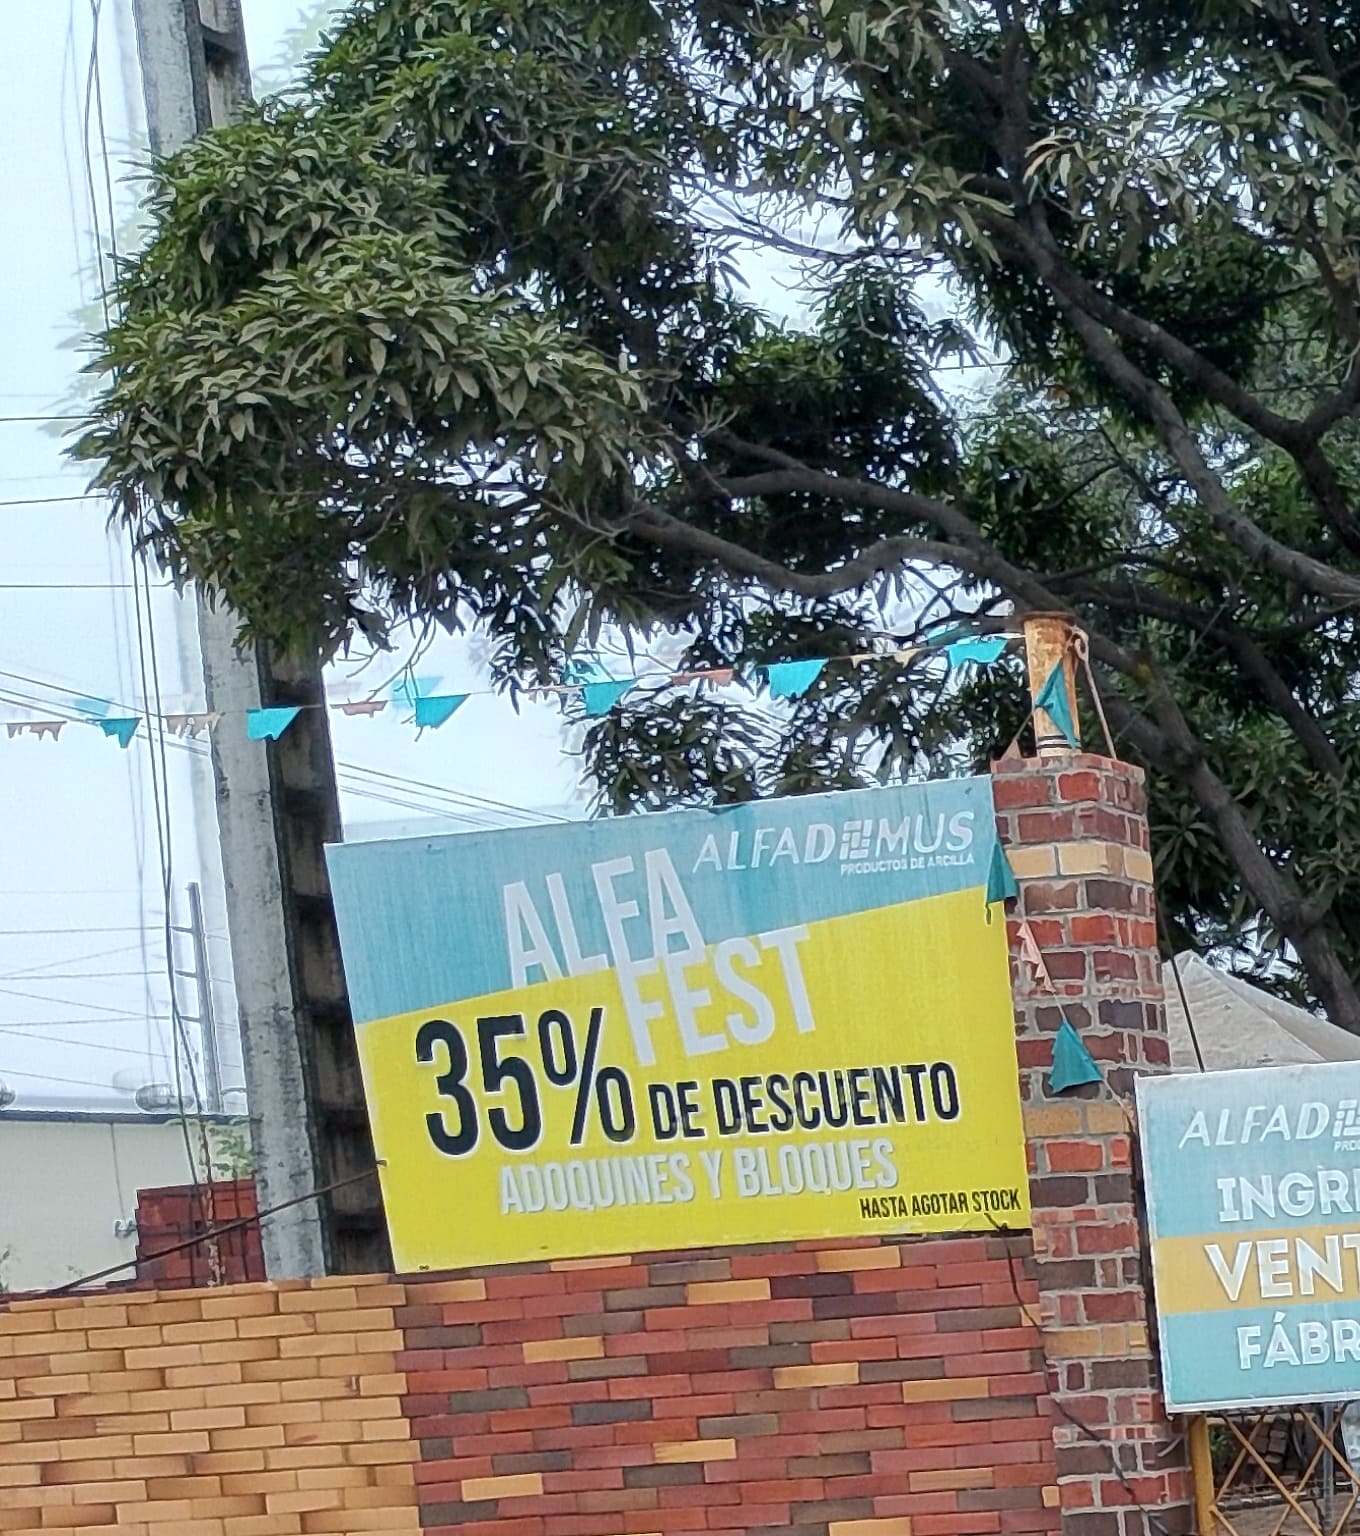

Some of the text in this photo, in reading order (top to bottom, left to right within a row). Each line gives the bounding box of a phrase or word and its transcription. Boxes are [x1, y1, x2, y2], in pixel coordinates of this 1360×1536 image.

[840, 853, 974, 875] PRODUCTOS DE ARCILLA
[503, 848, 706, 989] ALFA
[614, 924, 815, 1067] FEST
[415, 1008, 961, 1157] 35% DE DESCUENTO
[501, 1139, 898, 1214] ADOQUINES Y BLOQUES
[860, 1188, 1022, 1219] HASTA AGOTAR STOCK
